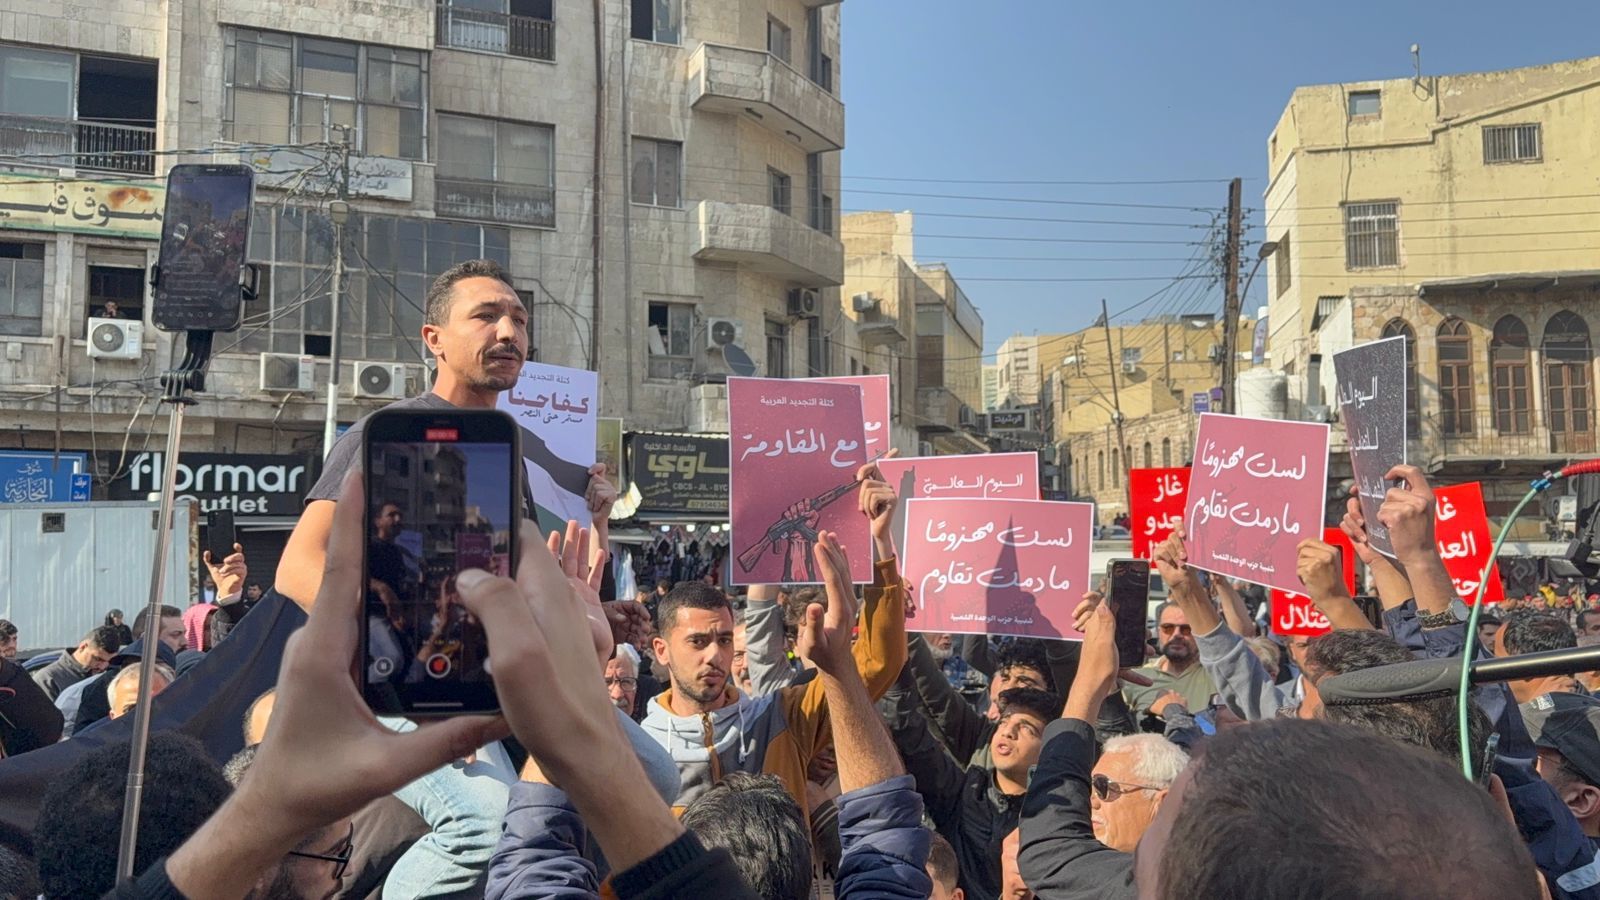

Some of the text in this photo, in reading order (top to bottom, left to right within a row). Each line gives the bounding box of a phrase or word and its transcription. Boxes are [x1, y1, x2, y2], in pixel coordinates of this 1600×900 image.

[0, 185, 163, 227] سوق في
[508, 388, 589, 414] كفاحنا
[760, 395, 835, 408] كتلة التجديد العربية
[741, 428, 858, 467] مع المقاومة
[129, 452, 305, 492] flormar
[648, 451, 729, 480] اوي
[1244, 452, 1306, 480] لست
[983, 473, 1024, 499] اليوم
[1152, 474, 1184, 503] غاز
[176, 494, 268, 513] utlet
[1189, 489, 1228, 541] تقاوم
[1435, 496, 1456, 521] غا
[997, 526, 1073, 548] لست
[1144, 512, 1183, 536] عدو
[1439, 530, 1477, 559] العد
[920, 560, 973, 610] تقاوم
[1451, 568, 1488, 596] احت
[1280, 603, 1331, 631] حتلال
